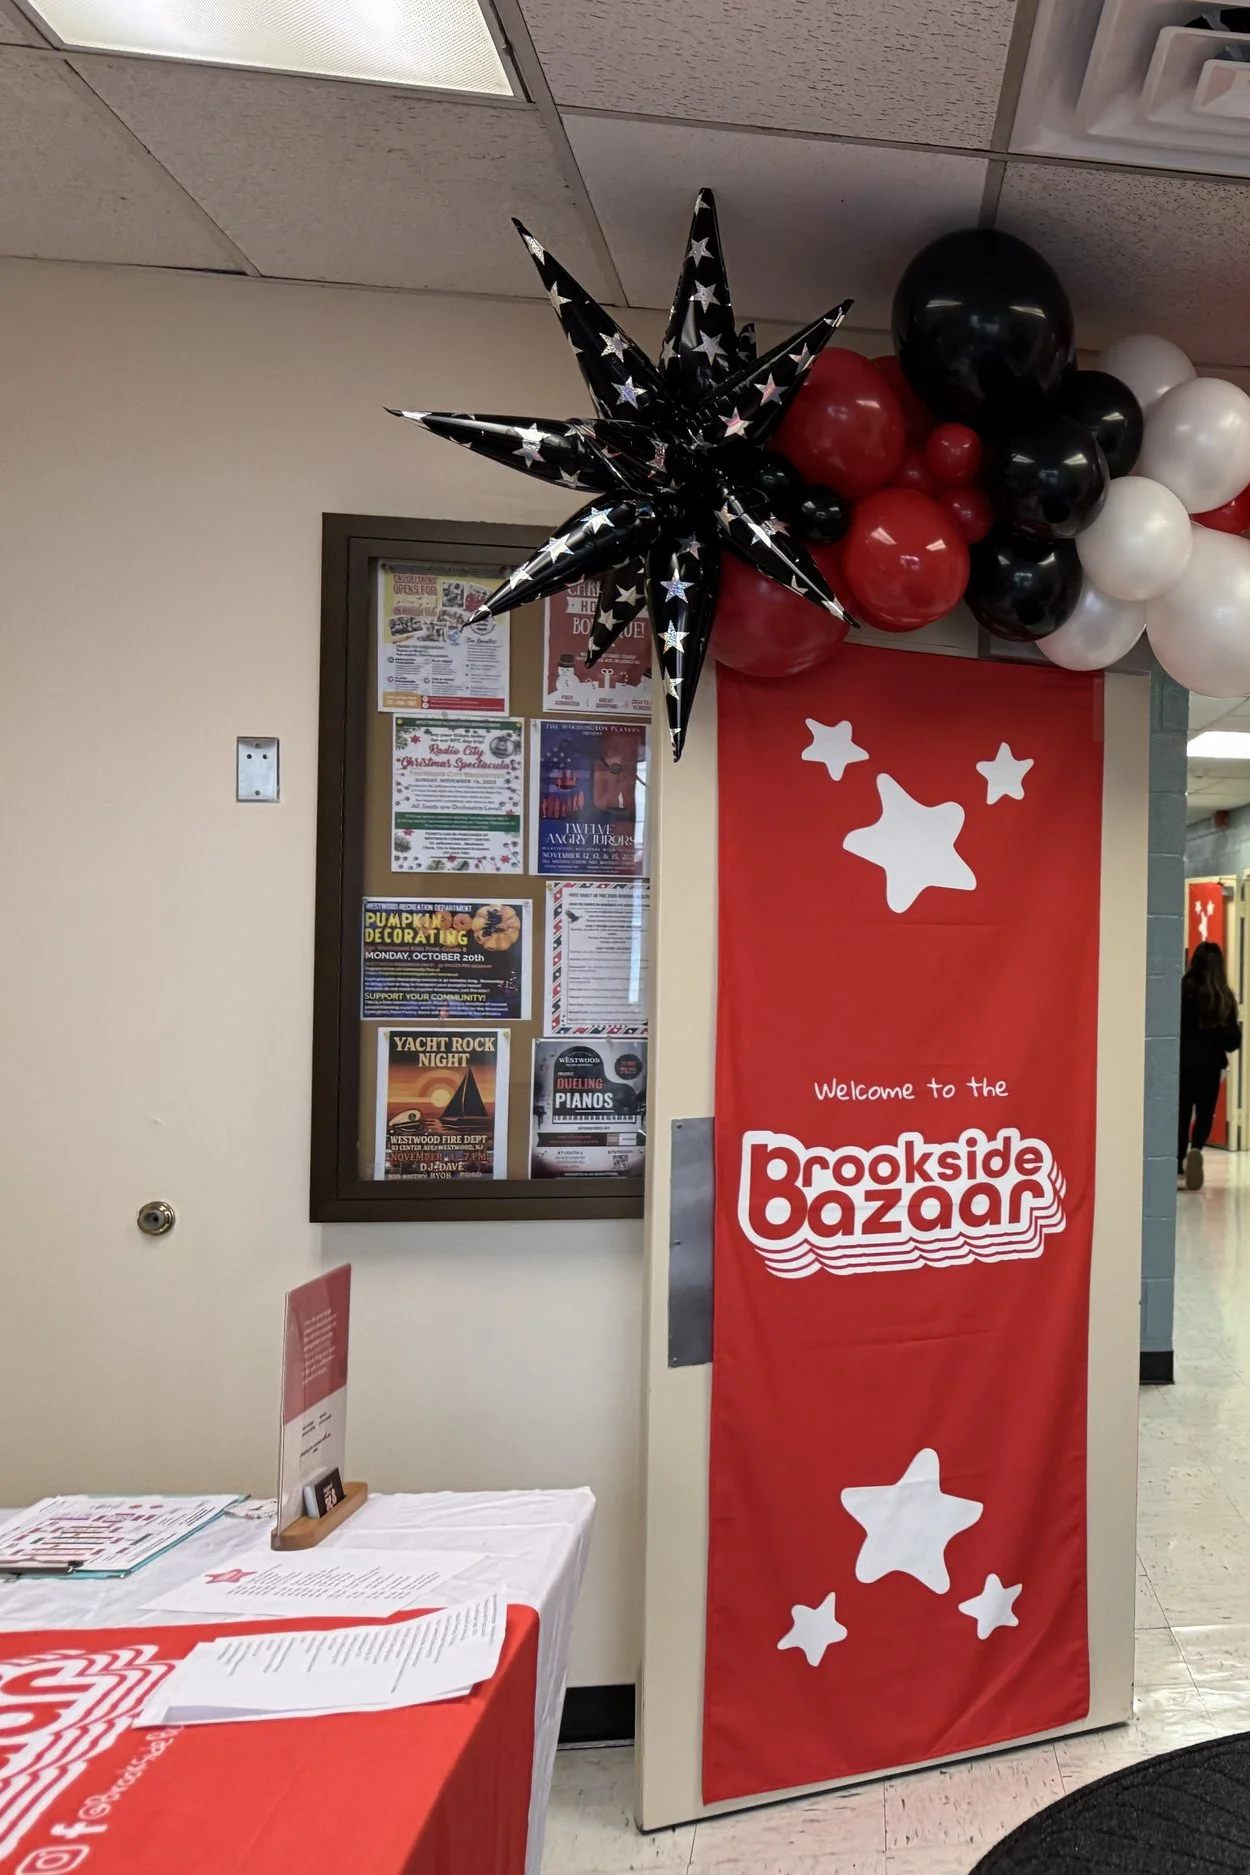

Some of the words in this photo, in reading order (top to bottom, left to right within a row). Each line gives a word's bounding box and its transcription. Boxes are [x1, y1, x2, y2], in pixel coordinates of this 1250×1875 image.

[428, 744, 459, 756] Radio
[463, 745, 484, 759] City
[401, 756, 452, 769] Christmas
[565, 823, 616, 835] TWELVE
[547, 833, 589, 845] ANGRY
[593, 834, 636, 846] JURORS
[434, 904, 472, 912] DEPARTMENT
[365, 912, 442, 929] PUMPKIN
[365, 928, 468, 945] DECORATING
[365, 951, 411, 961] MONDAY,
[412, 952, 461, 961] OCTOBER
[462, 954, 485, 962] 20th
[364, 992, 404, 1000] SUPPORT
[431, 993, 486, 1001] COMMUNITY!
[393, 1036, 449, 1052] YACHT
[451, 1037, 496, 1052] ROCK
[418, 1053, 470, 1068] NIGHT
[558, 1056, 600, 1064] WESTWOOD
[557, 1078, 604, 1090] DUELING
[815, 1077, 915, 1101] Welcome
[926, 1077, 956, 1099] to
[967, 1076, 1009, 1098] the
[555, 1092, 614, 1109] PIANOS
[390, 1135, 441, 1144] WESTWOOD
[442, 1135, 462, 1144] FIRE
[463, 1135, 488, 1144] DEPT
[391, 1151, 443, 1161] NOVEMBER
[472, 1152, 486, 1161] PM
[748, 1134, 1045, 1188] Brookside
[420, 1162, 434, 1171] DJ
[439, 1161, 465, 1171] DAVE
[748, 1178, 1046, 1241] Bazaar
